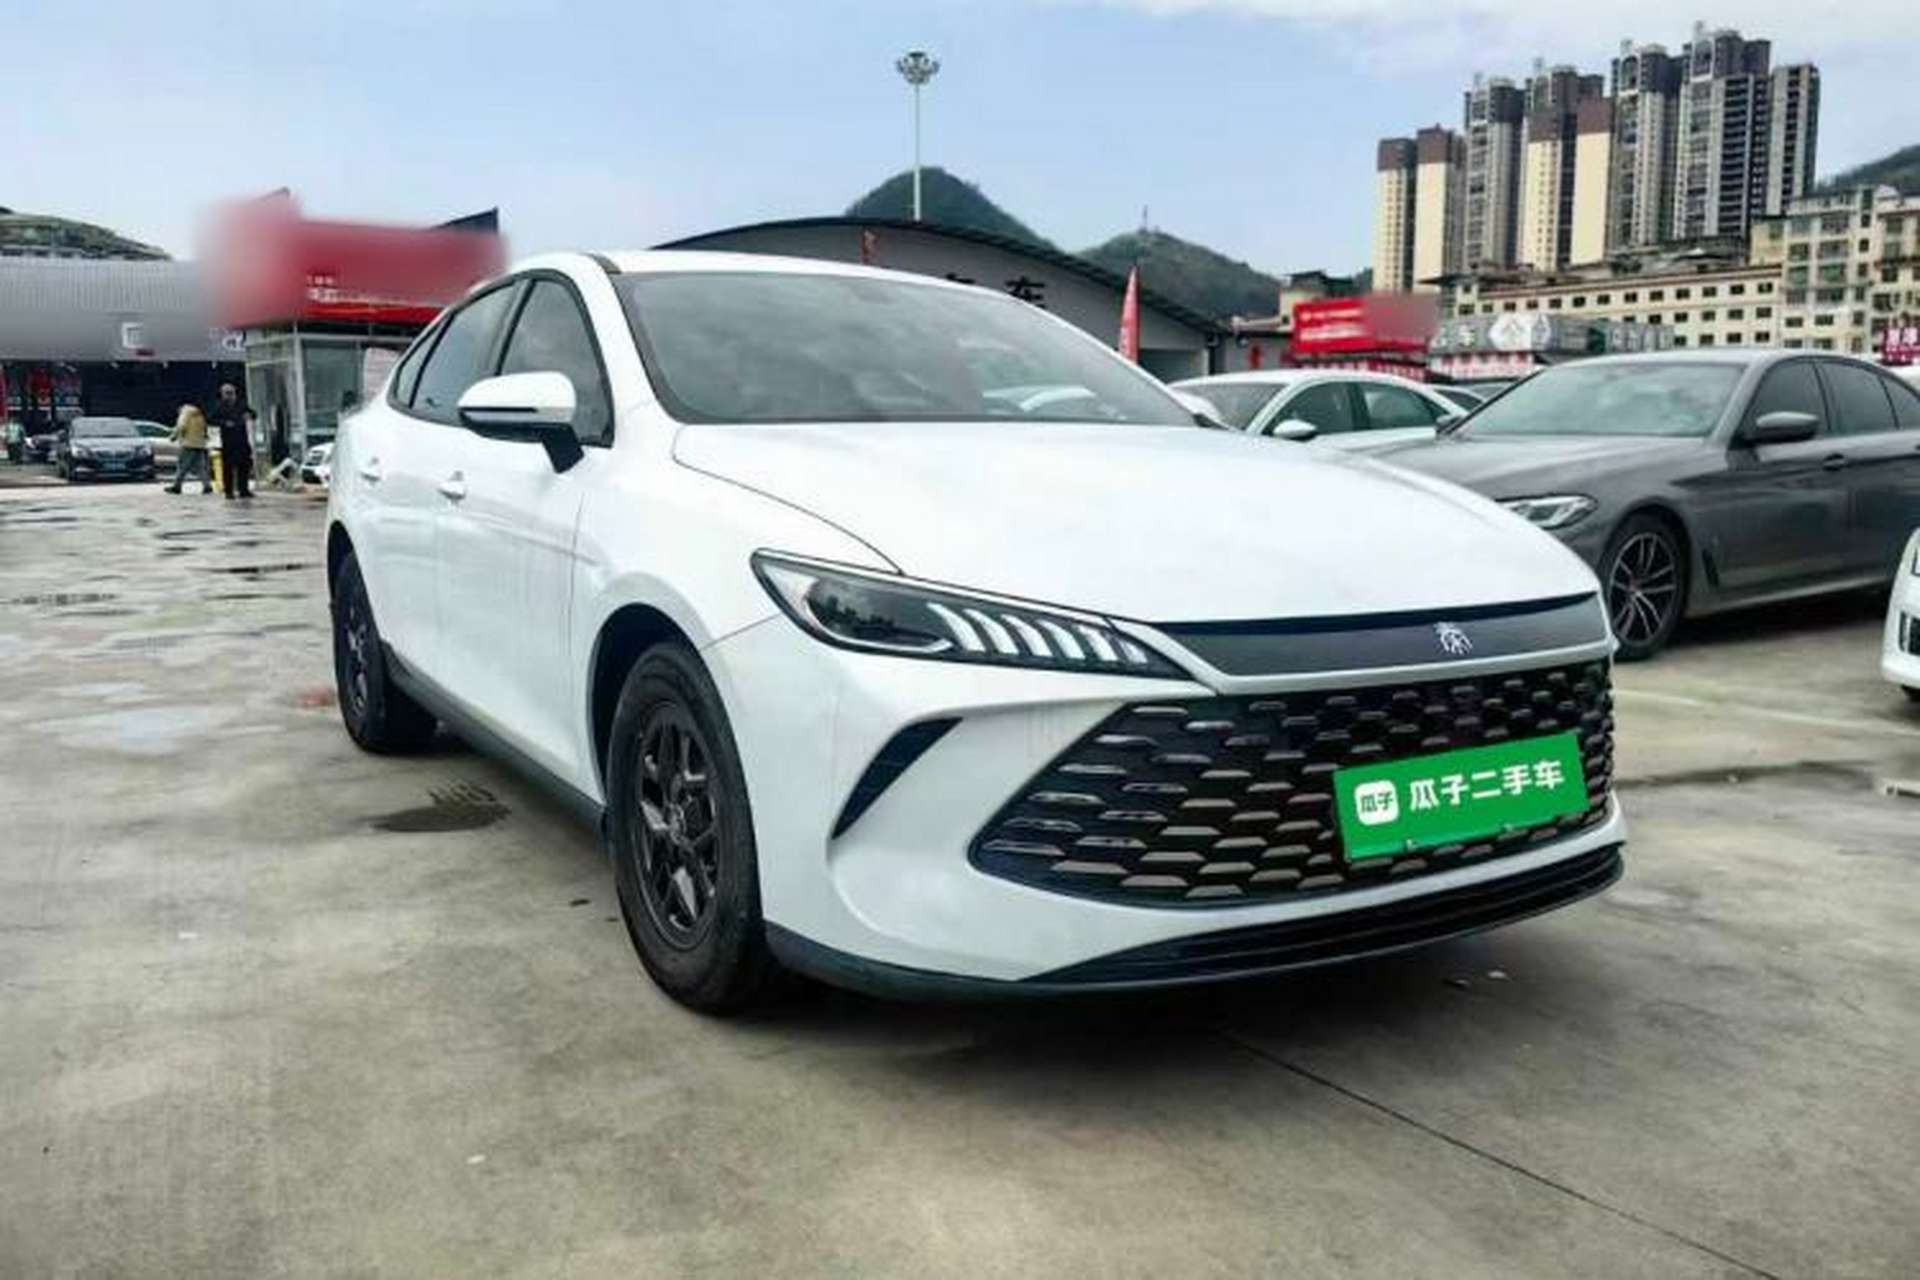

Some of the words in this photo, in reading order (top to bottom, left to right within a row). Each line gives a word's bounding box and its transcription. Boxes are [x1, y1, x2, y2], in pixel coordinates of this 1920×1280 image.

[1360, 791, 1394, 813] 瓜子
[1409, 760, 1565, 812] 瓜子二手车
